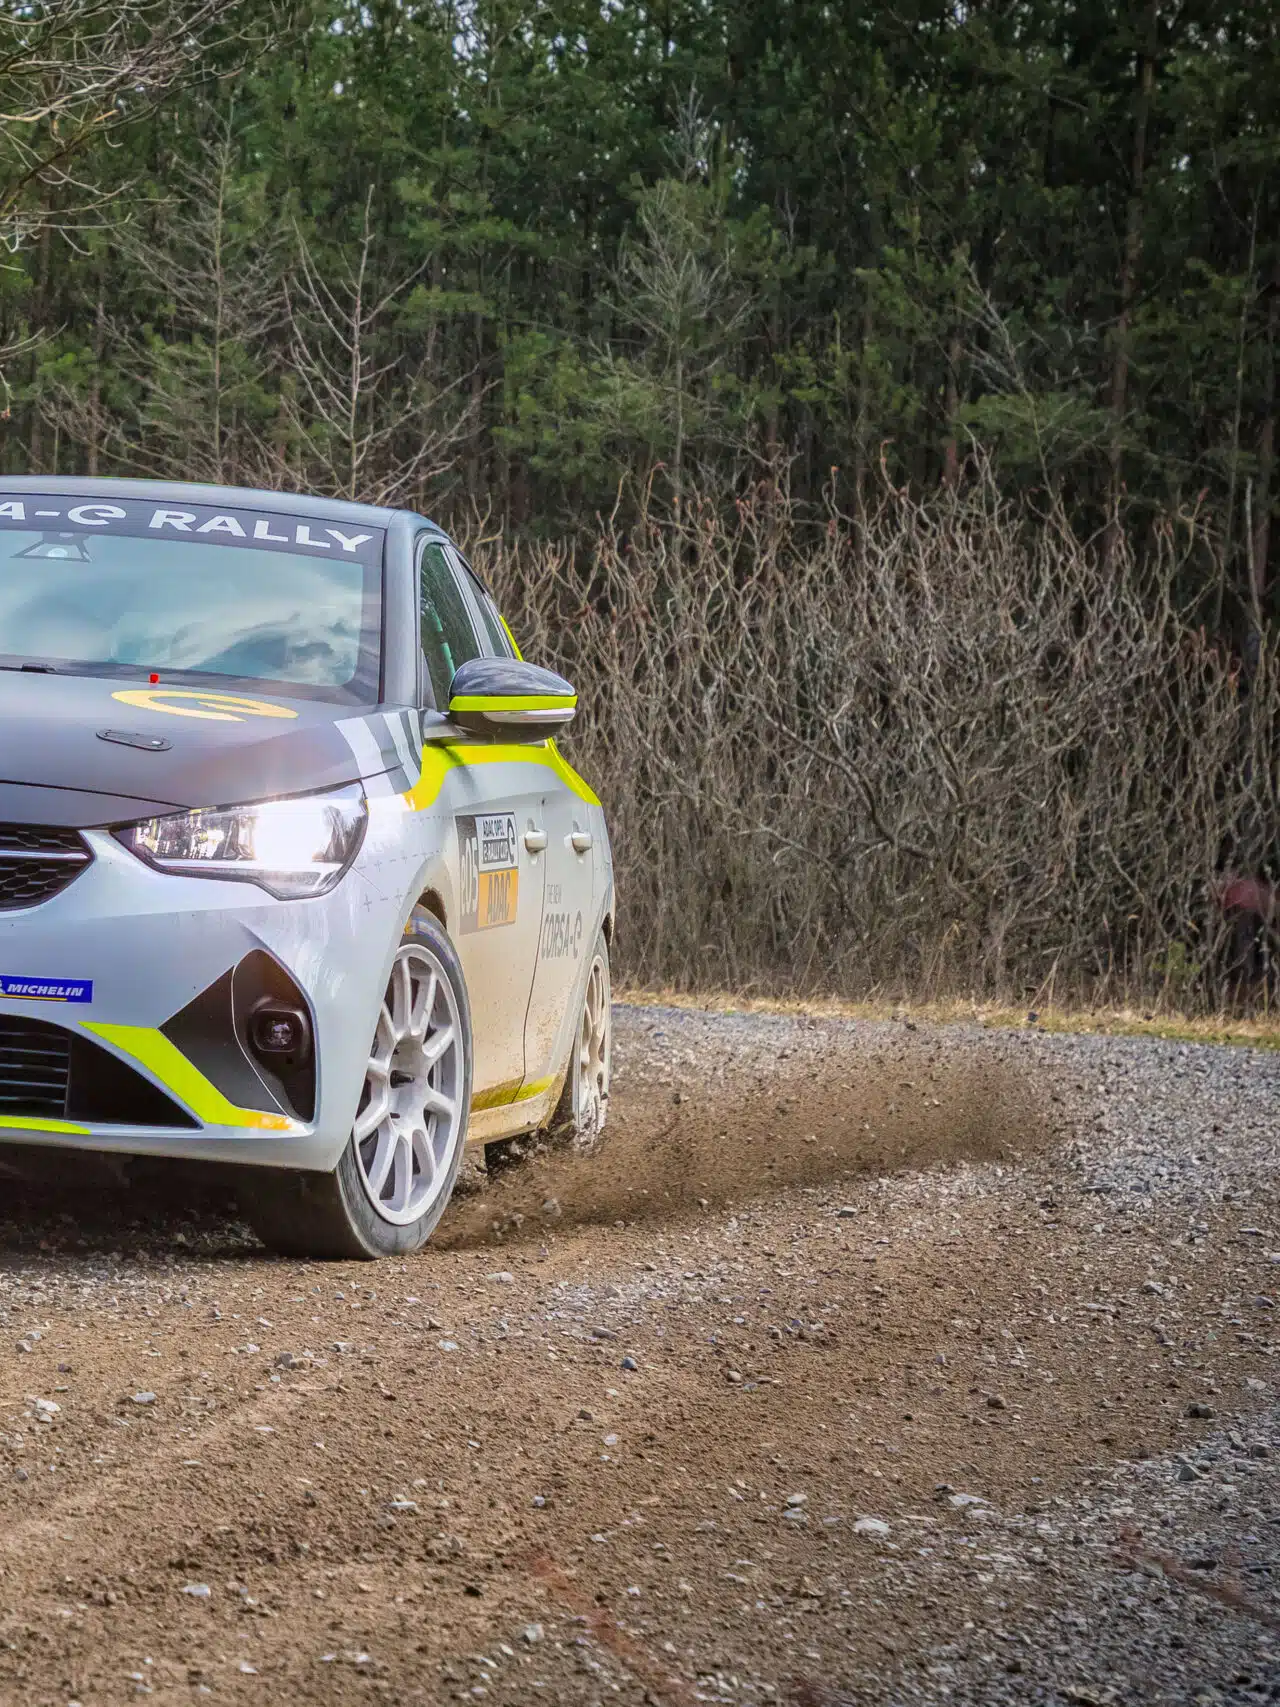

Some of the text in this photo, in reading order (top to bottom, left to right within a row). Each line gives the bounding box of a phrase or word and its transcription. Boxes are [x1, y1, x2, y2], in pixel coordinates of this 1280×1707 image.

[148, 509, 373, 553] RALLY
[487, 871, 511, 924] ADAC
[7, 983, 86, 998] MICHELIN
